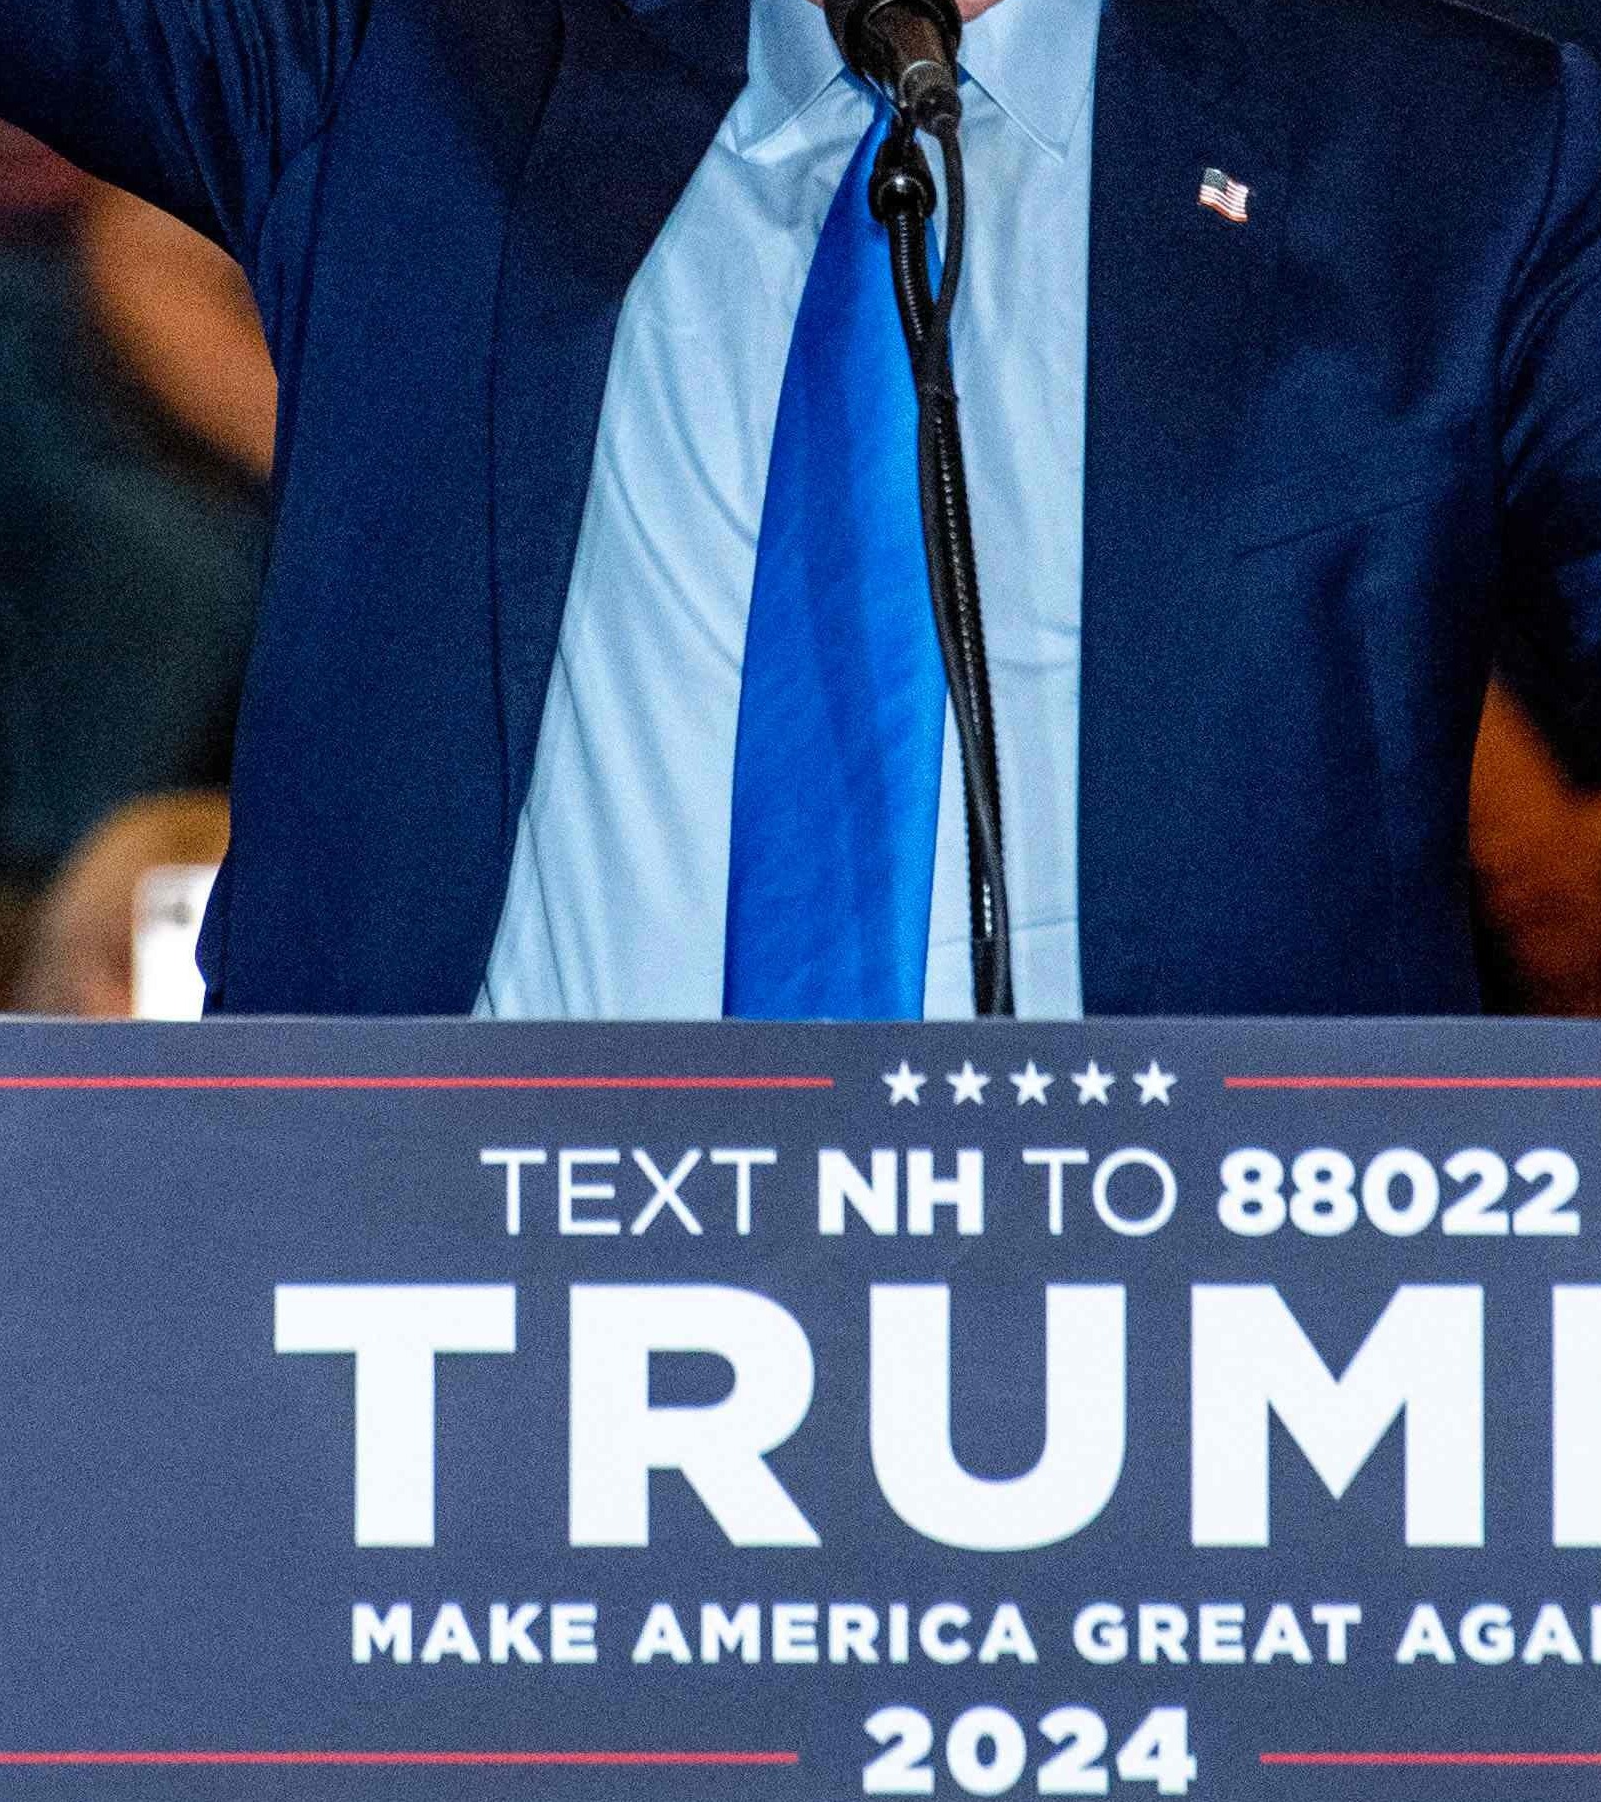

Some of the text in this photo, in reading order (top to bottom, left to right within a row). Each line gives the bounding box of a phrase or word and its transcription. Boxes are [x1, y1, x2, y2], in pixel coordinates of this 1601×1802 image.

[479, 1148, 1581, 1237] TEXT NH TO 88022
[351, 1602, 599, 1664] MAKE
[631, 1602, 1038, 1664] AMERICA
[1072, 1602, 1363, 1664] GREAT
[862, 1705, 1198, 1796] 2024
